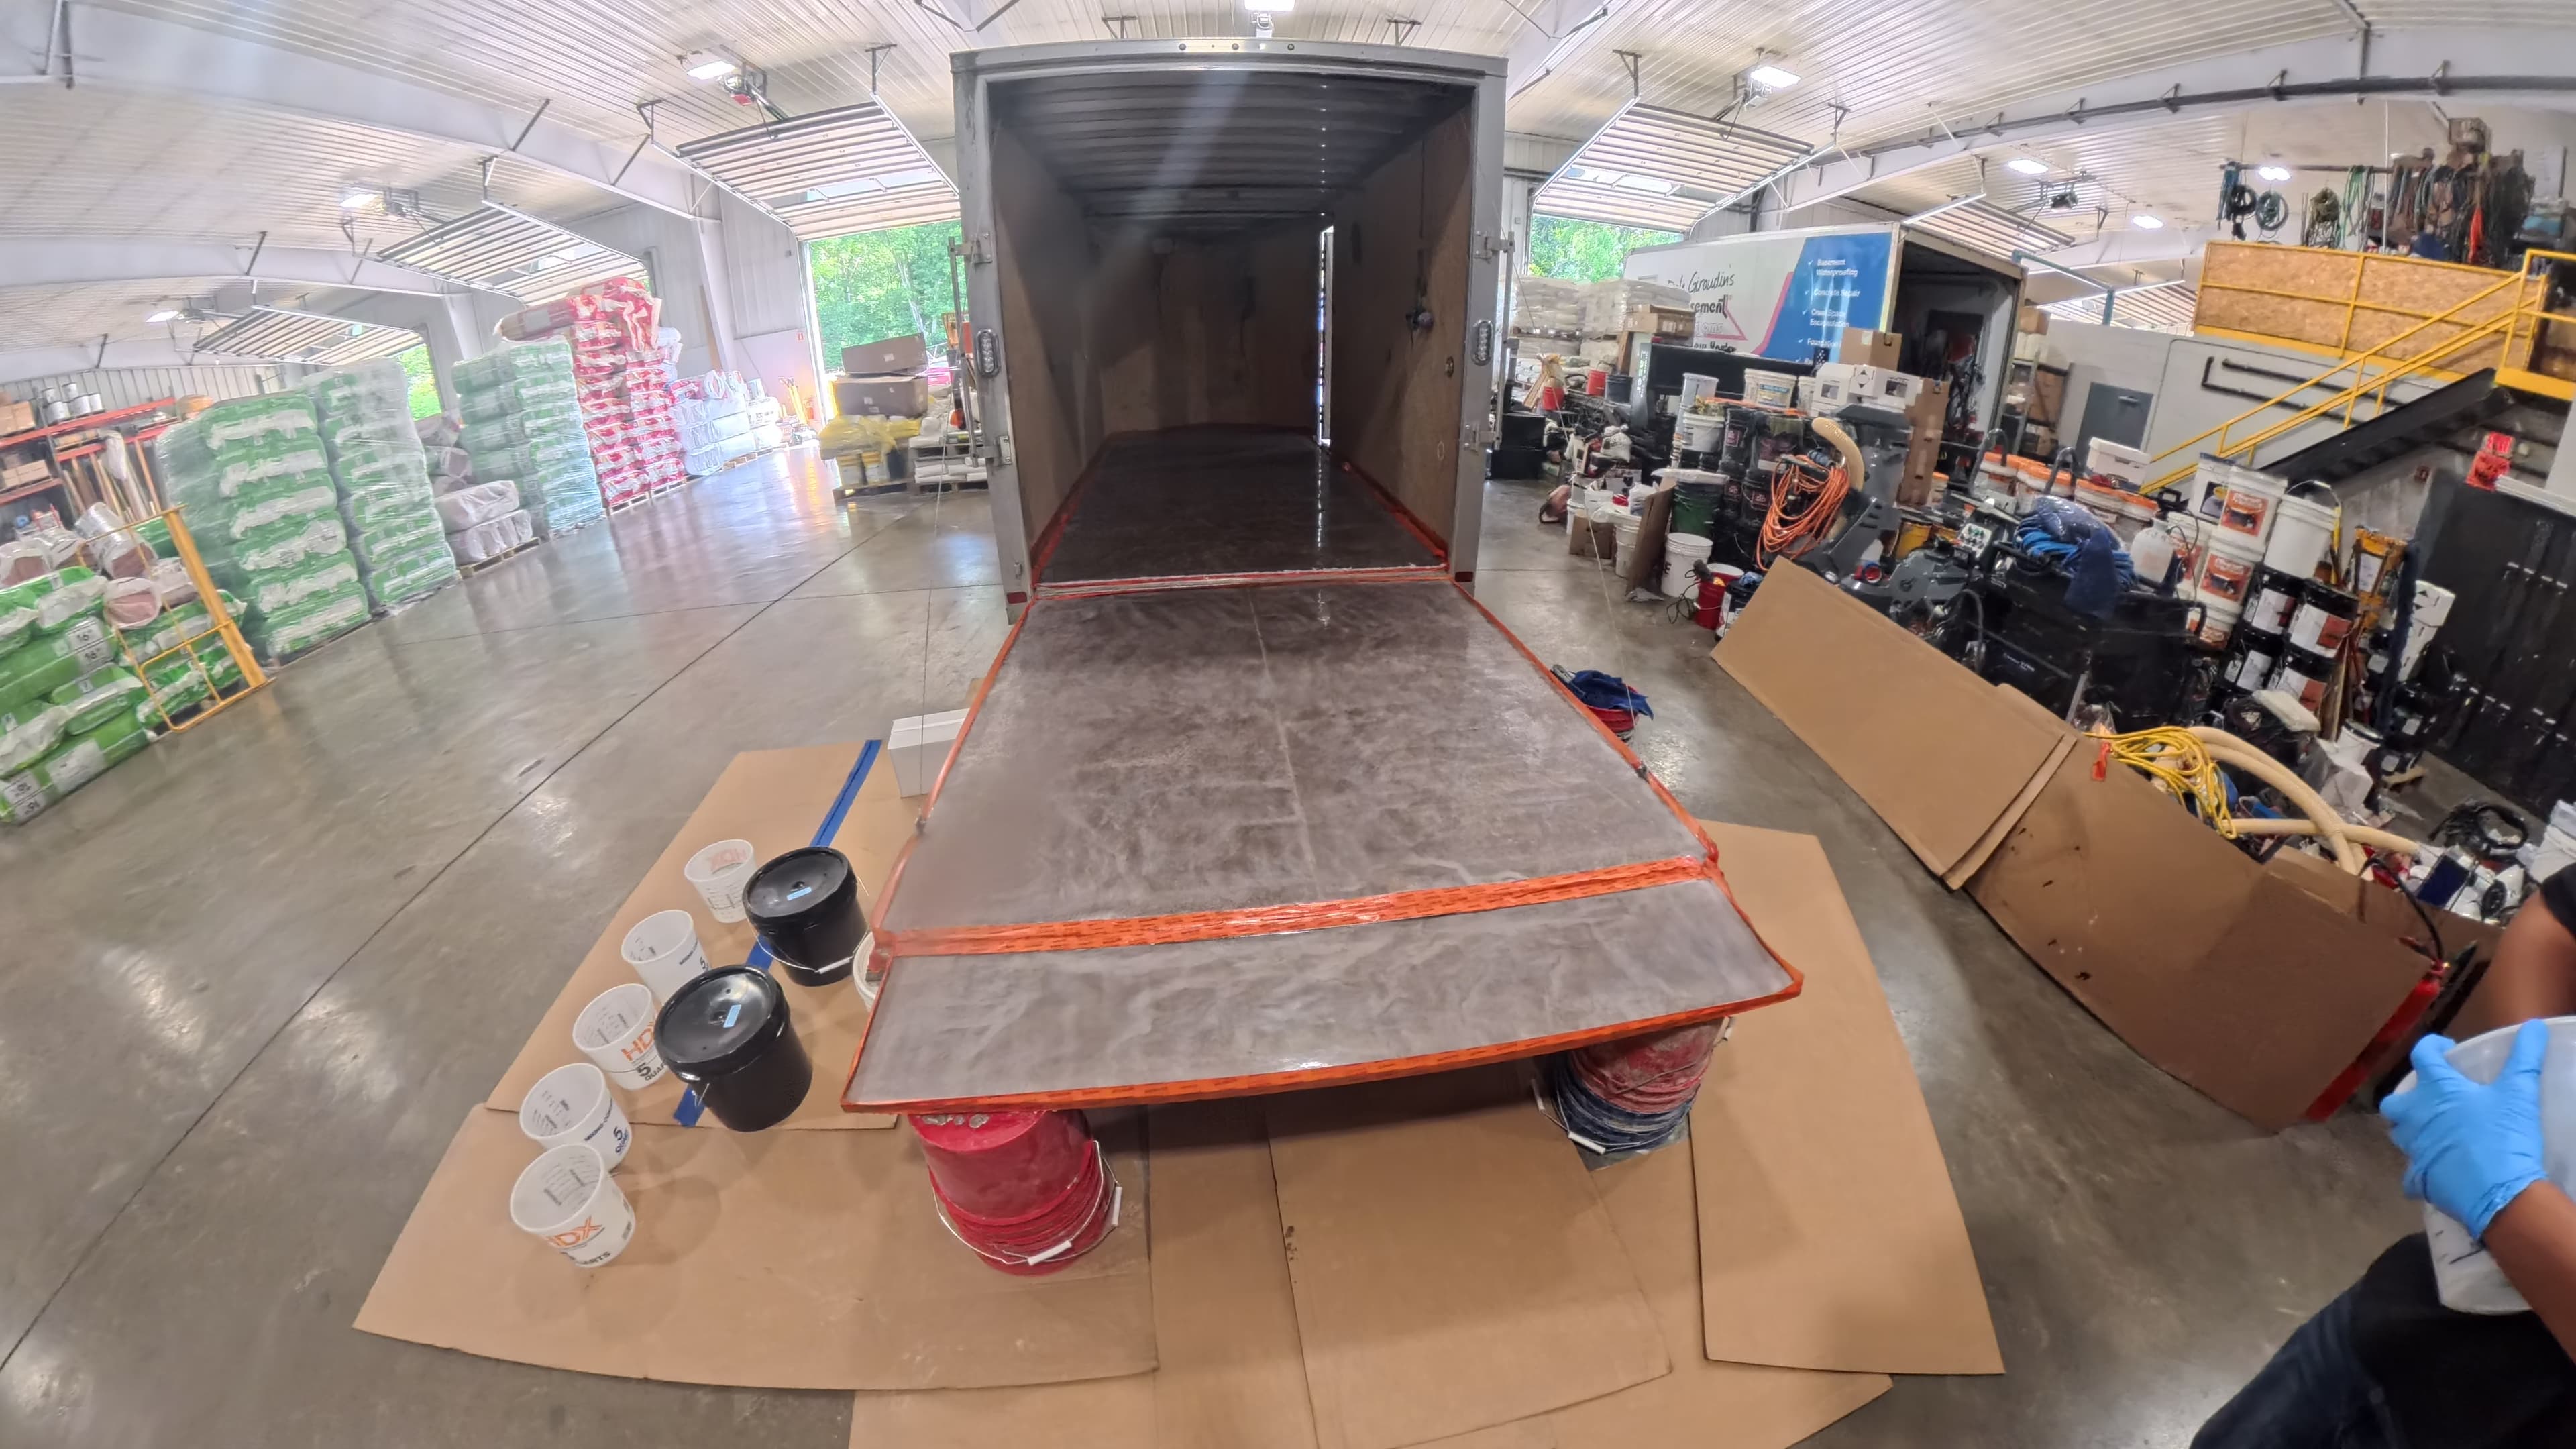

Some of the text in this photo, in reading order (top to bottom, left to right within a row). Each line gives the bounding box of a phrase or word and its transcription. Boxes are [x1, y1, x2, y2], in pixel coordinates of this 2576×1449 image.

[1813, 288, 1861, 297] Concrete Repair
[621, 1021, 655, 1062] HD
[637, 1062, 651, 1077] 5
[645, 1061, 667, 1081] QUAR
[613, 1126, 623, 1141] 5
